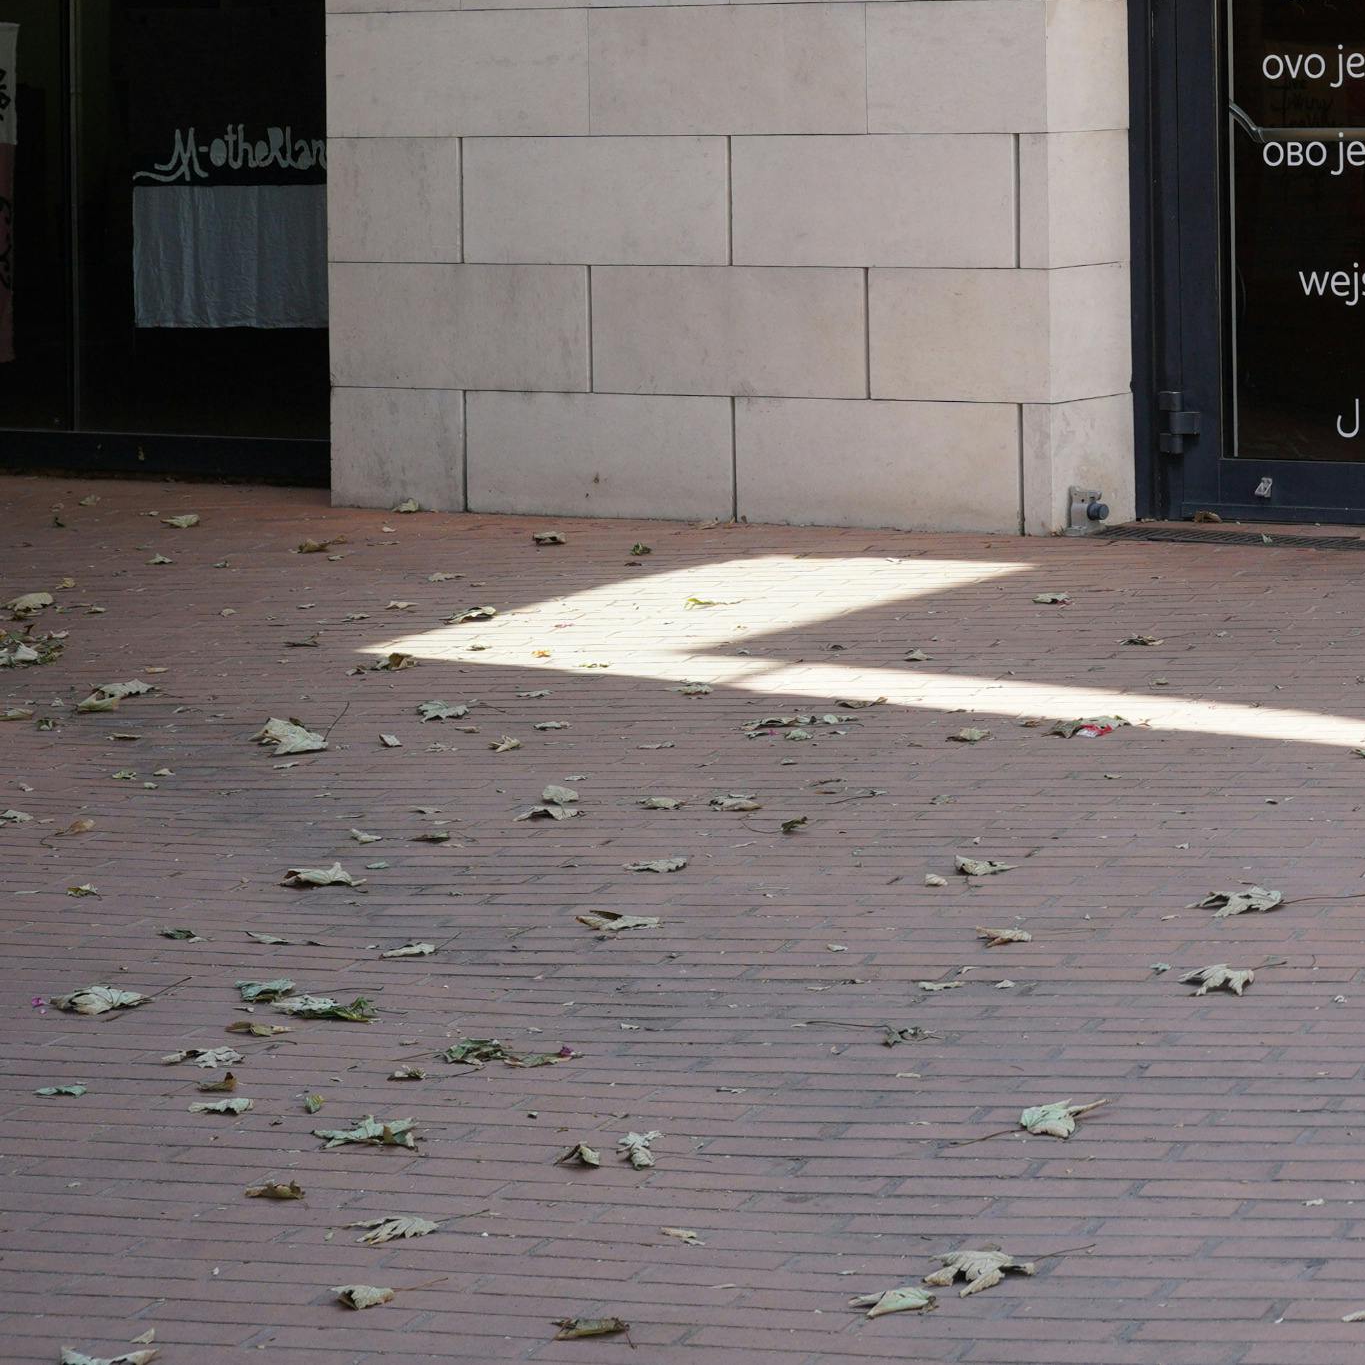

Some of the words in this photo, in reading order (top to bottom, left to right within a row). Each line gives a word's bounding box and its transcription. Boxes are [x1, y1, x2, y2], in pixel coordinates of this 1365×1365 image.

[1262, 53, 1326, 80] ovo
[1329, 44, 1365, 88] je
[1262, 141, 1327, 167] ово
[1336, 398, 1360, 438] ل
